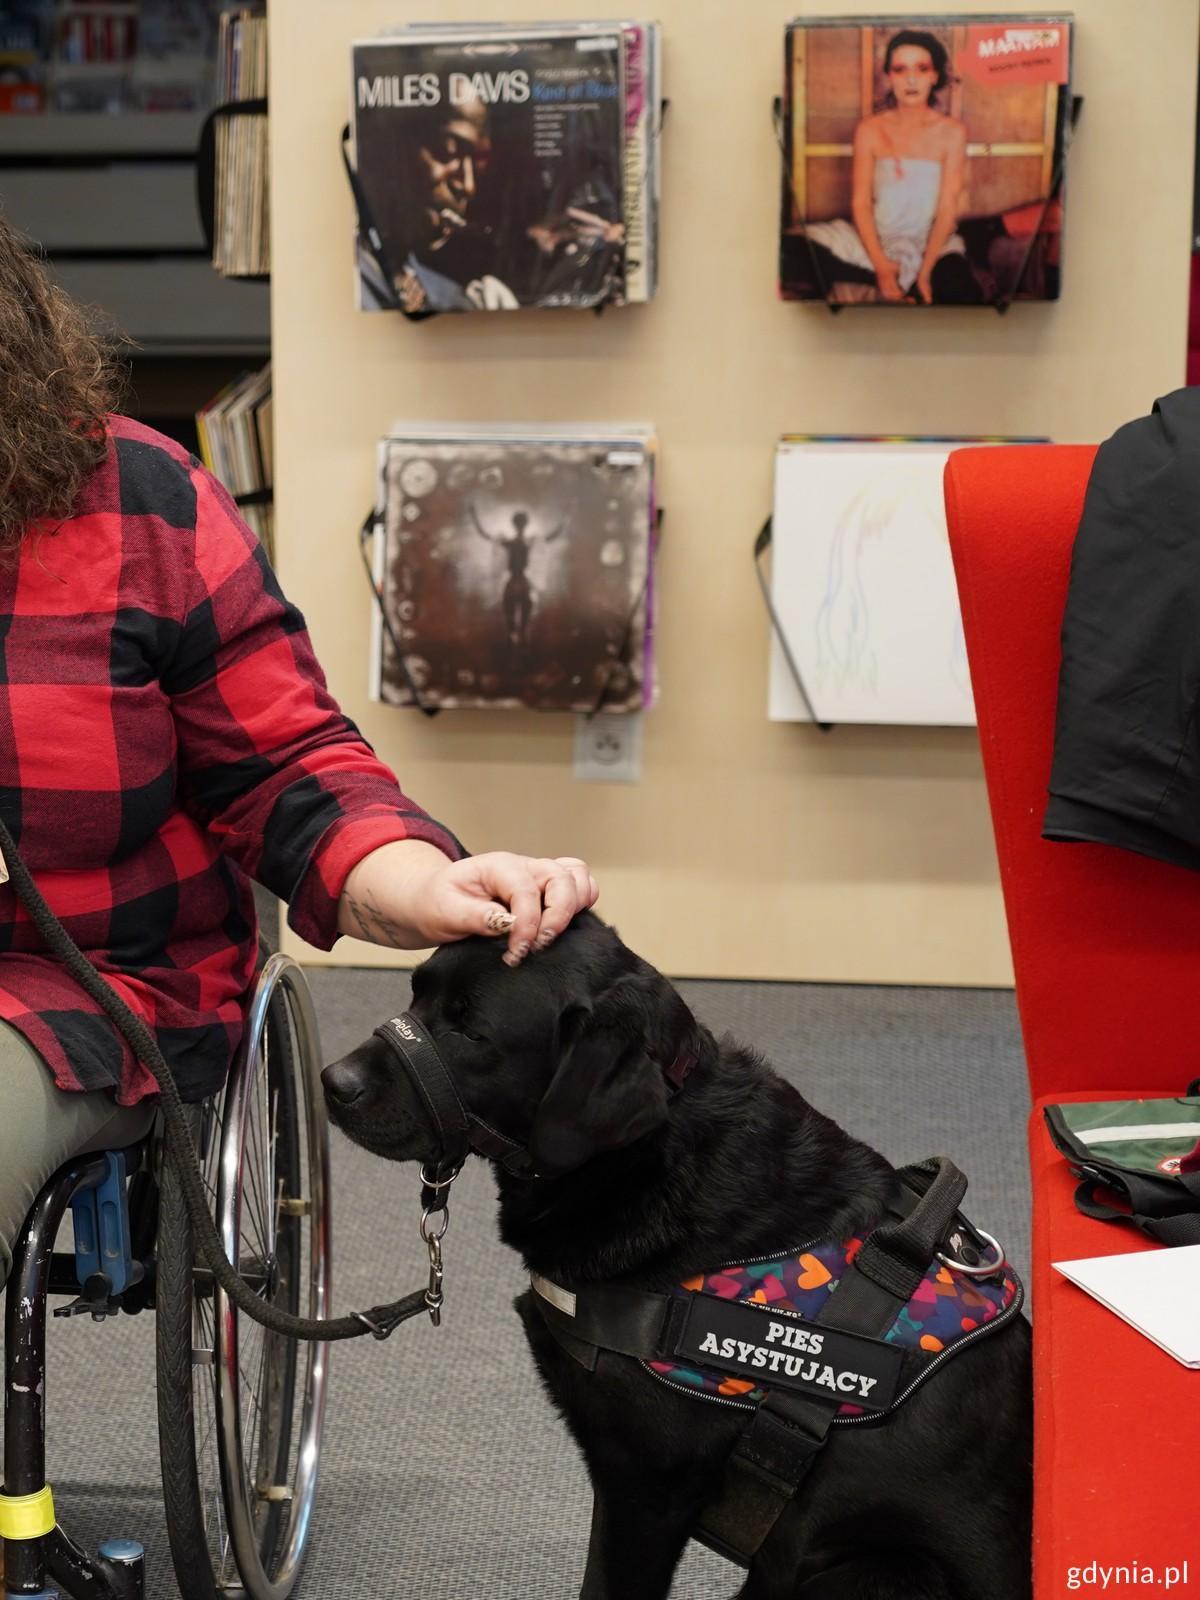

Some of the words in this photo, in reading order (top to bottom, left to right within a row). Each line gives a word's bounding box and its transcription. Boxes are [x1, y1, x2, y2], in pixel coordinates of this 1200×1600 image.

[357, 73, 441, 108] MILES
[448, 69, 531, 105] DAVIS
[765, 1321, 825, 1355] PIES
